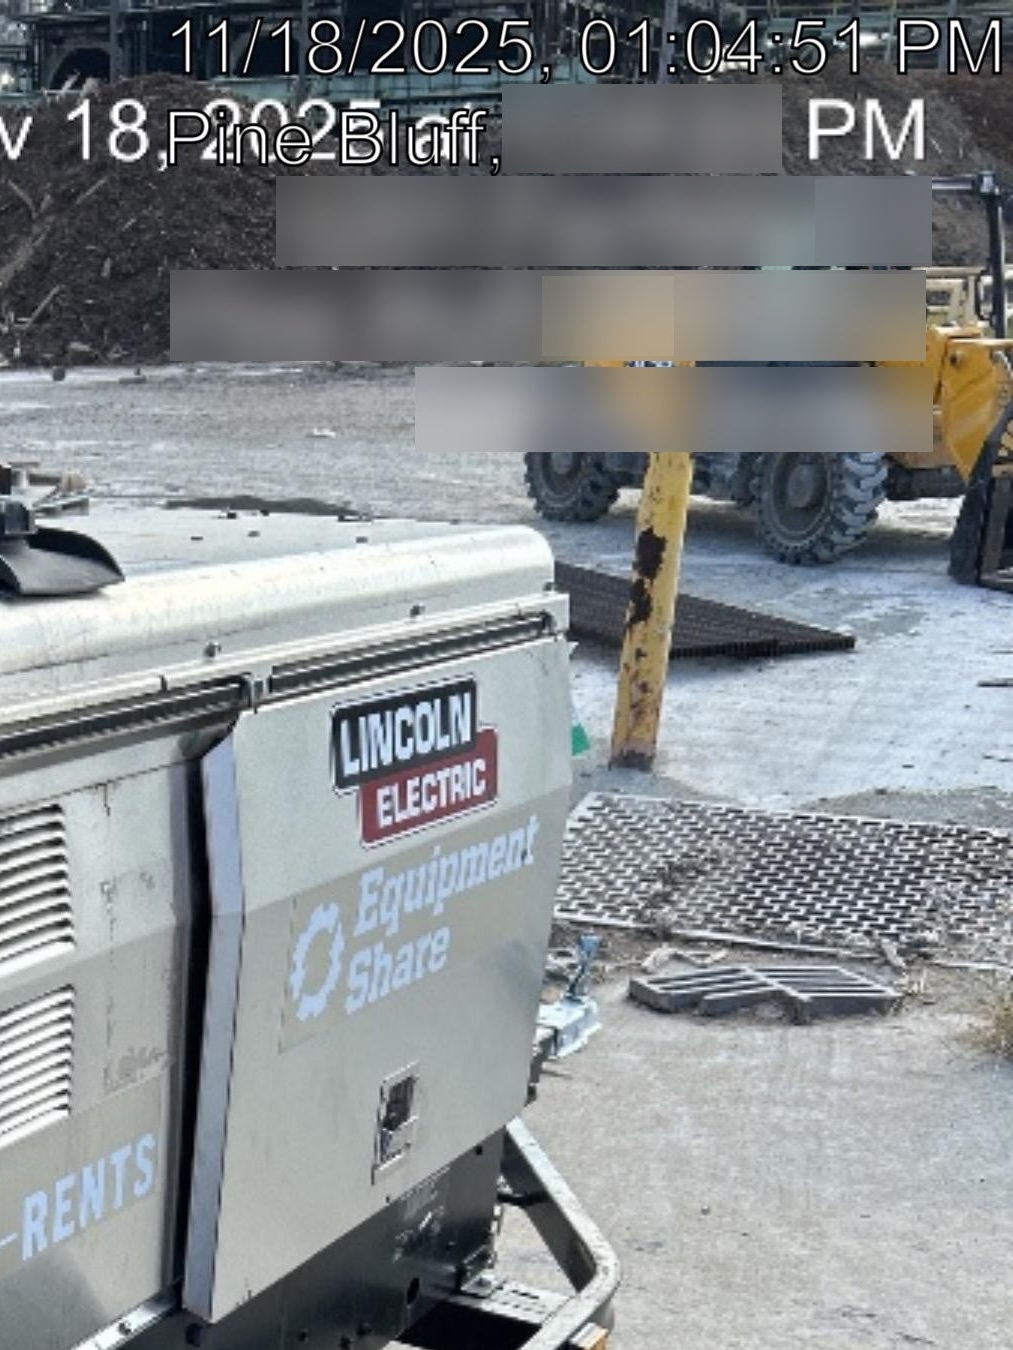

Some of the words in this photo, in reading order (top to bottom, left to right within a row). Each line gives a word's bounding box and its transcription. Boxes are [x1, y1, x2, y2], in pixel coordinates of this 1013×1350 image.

[340, 693, 472, 777] LINCOLN
[377, 758, 486, 829] ELECTRIC
[353, 814, 539, 937] Equipment
[342, 926, 450, 1016] Share
